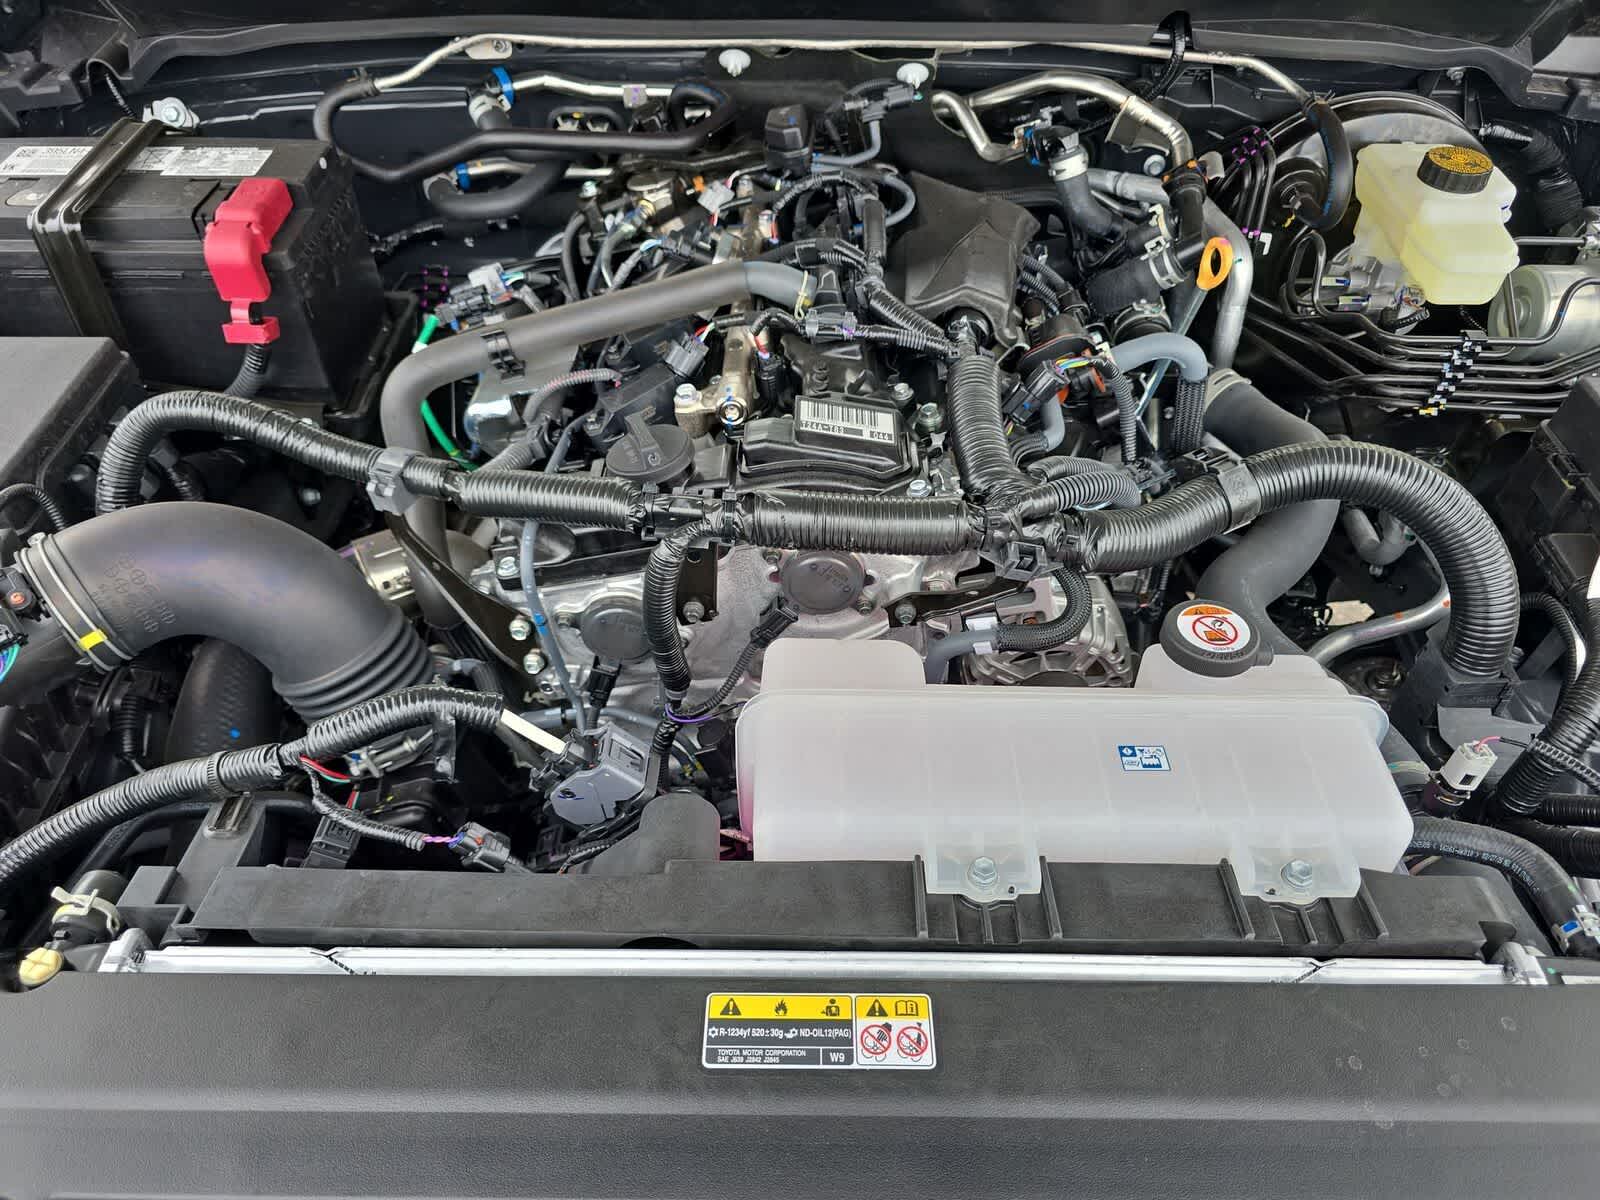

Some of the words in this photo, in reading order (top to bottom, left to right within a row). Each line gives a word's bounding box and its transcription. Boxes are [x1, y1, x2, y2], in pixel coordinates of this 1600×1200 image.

[719, 1027, 750, 1039] R-1234yf
[765, 1049, 807, 1057] CORPORATION
[829, 1051, 846, 1063] W9
